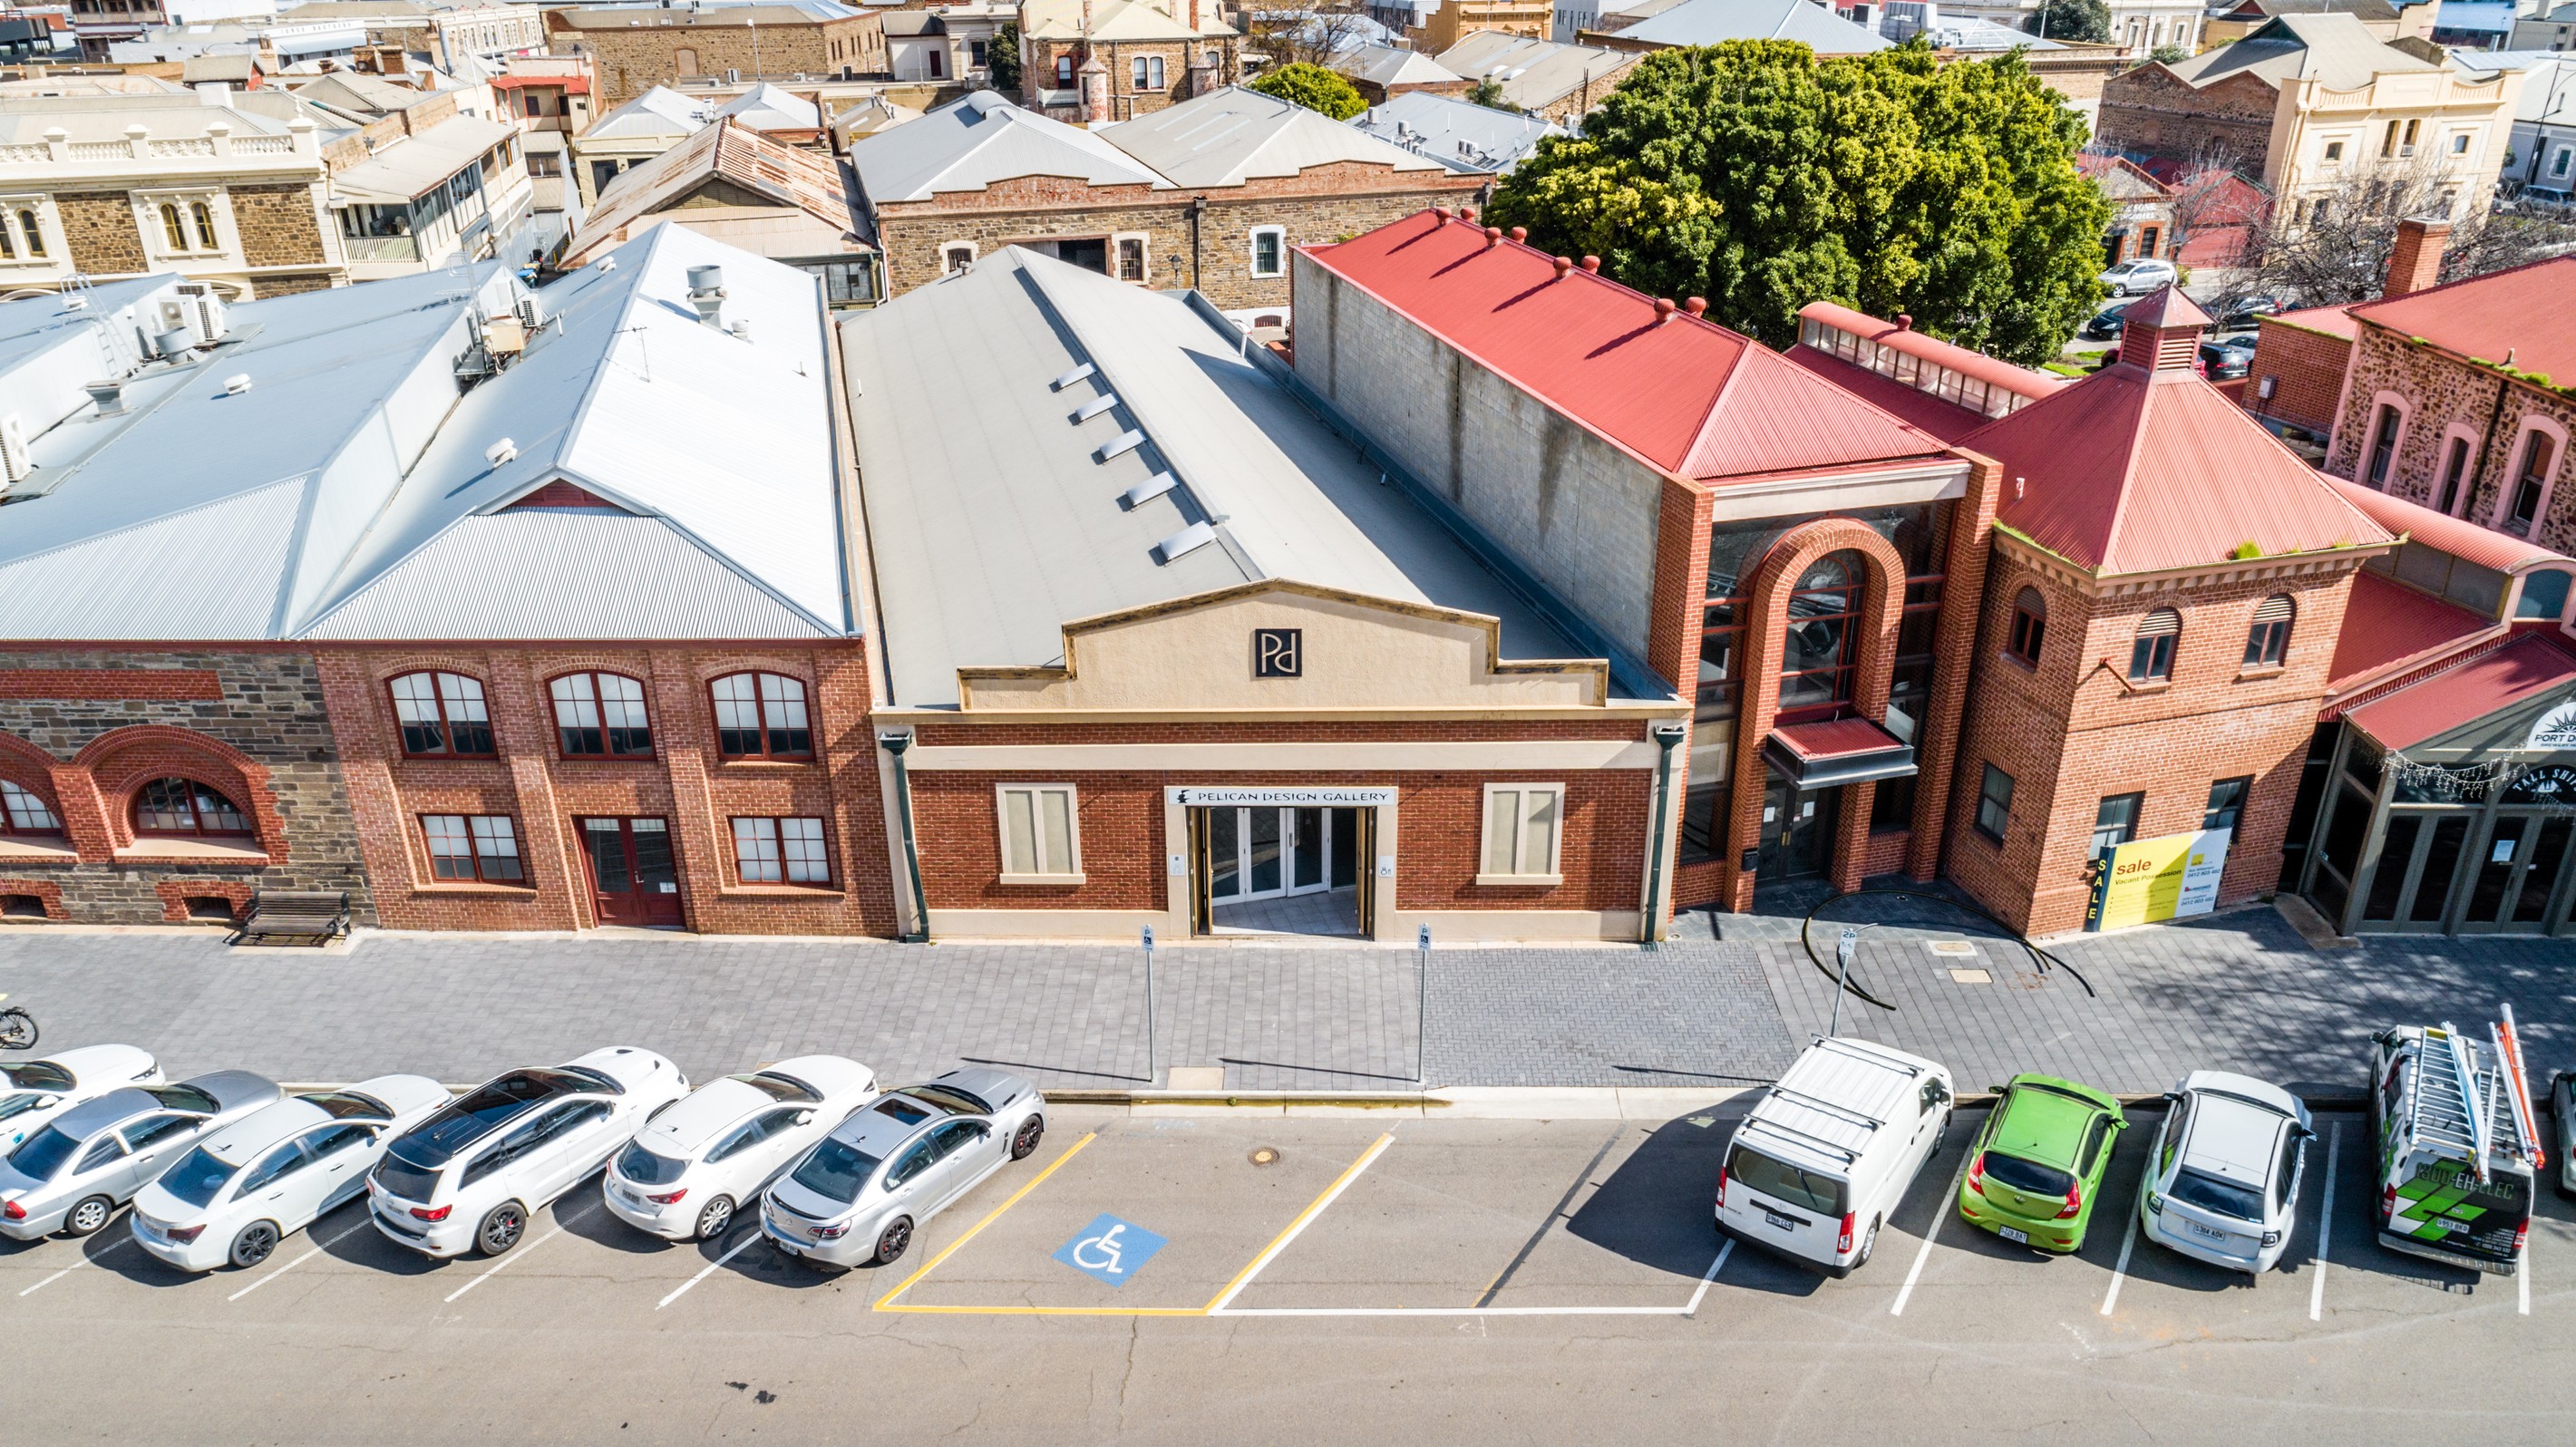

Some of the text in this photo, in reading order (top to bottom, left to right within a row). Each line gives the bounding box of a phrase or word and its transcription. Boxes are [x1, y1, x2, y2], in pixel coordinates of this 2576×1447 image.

[1261, 633, 1296, 673] Pd
[2513, 770, 2546, 791] TALL
[1198, 792, 1389, 801] PELICAN DESIGN GALLERY
[2116, 859, 2152, 876] sale
[2115, 869, 2182, 885] Vacant Possession
[2088, 859, 2107, 919] SALE
[1842, 930, 1856, 938] 2P
